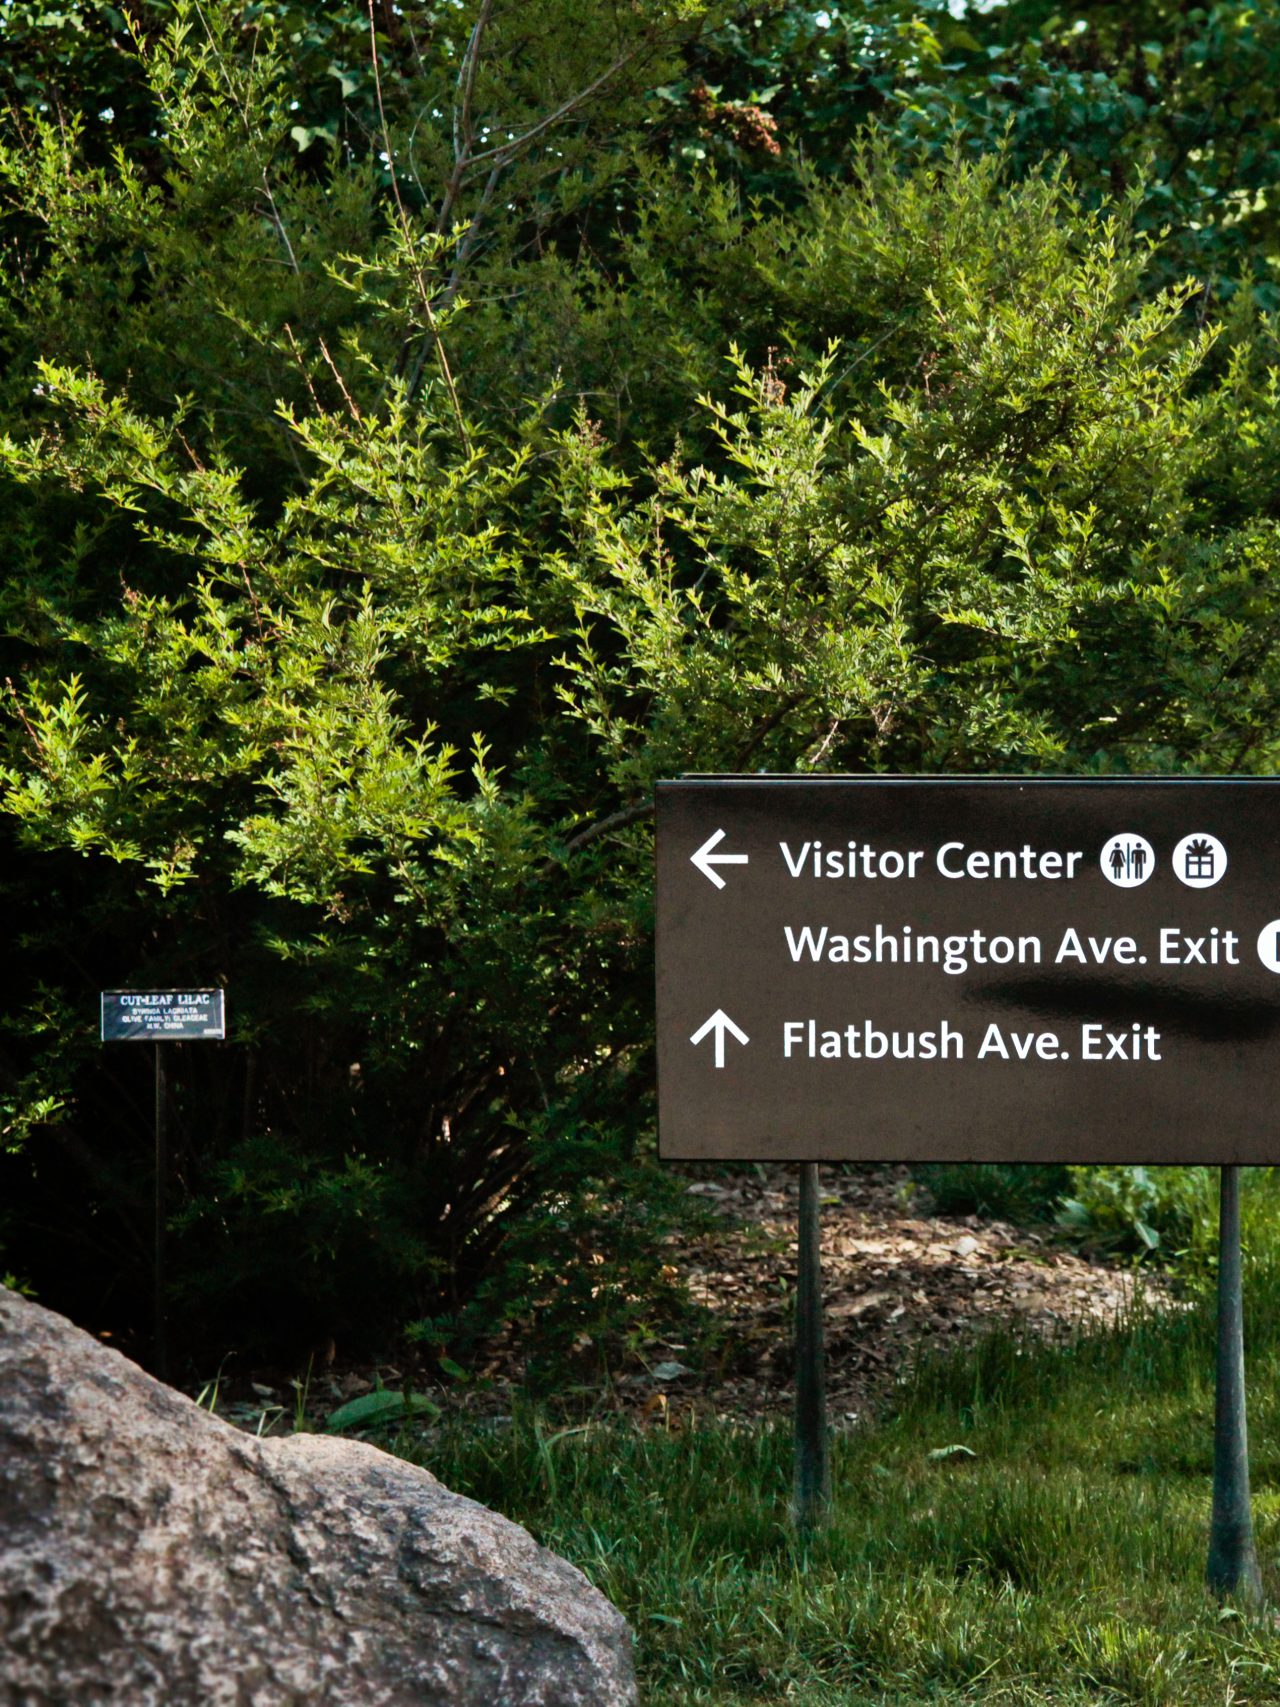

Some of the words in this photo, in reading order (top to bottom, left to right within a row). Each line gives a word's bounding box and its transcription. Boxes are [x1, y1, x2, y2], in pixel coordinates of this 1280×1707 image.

[780, 841, 925, 879] Visitor
[936, 842, 1083, 879] Center
[783, 925, 1041, 974] Washington
[1055, 927, 1148, 965] Ave.
[1159, 927, 1240, 965] Exit
[120, 995, 173, 1006] CUT-LEAF
[178, 994, 210, 1005] LILAC
[783, 1020, 963, 1059] Flatbush
[978, 1023, 1070, 1060] Ave.
[1083, 1022, 1162, 1061] Exit
